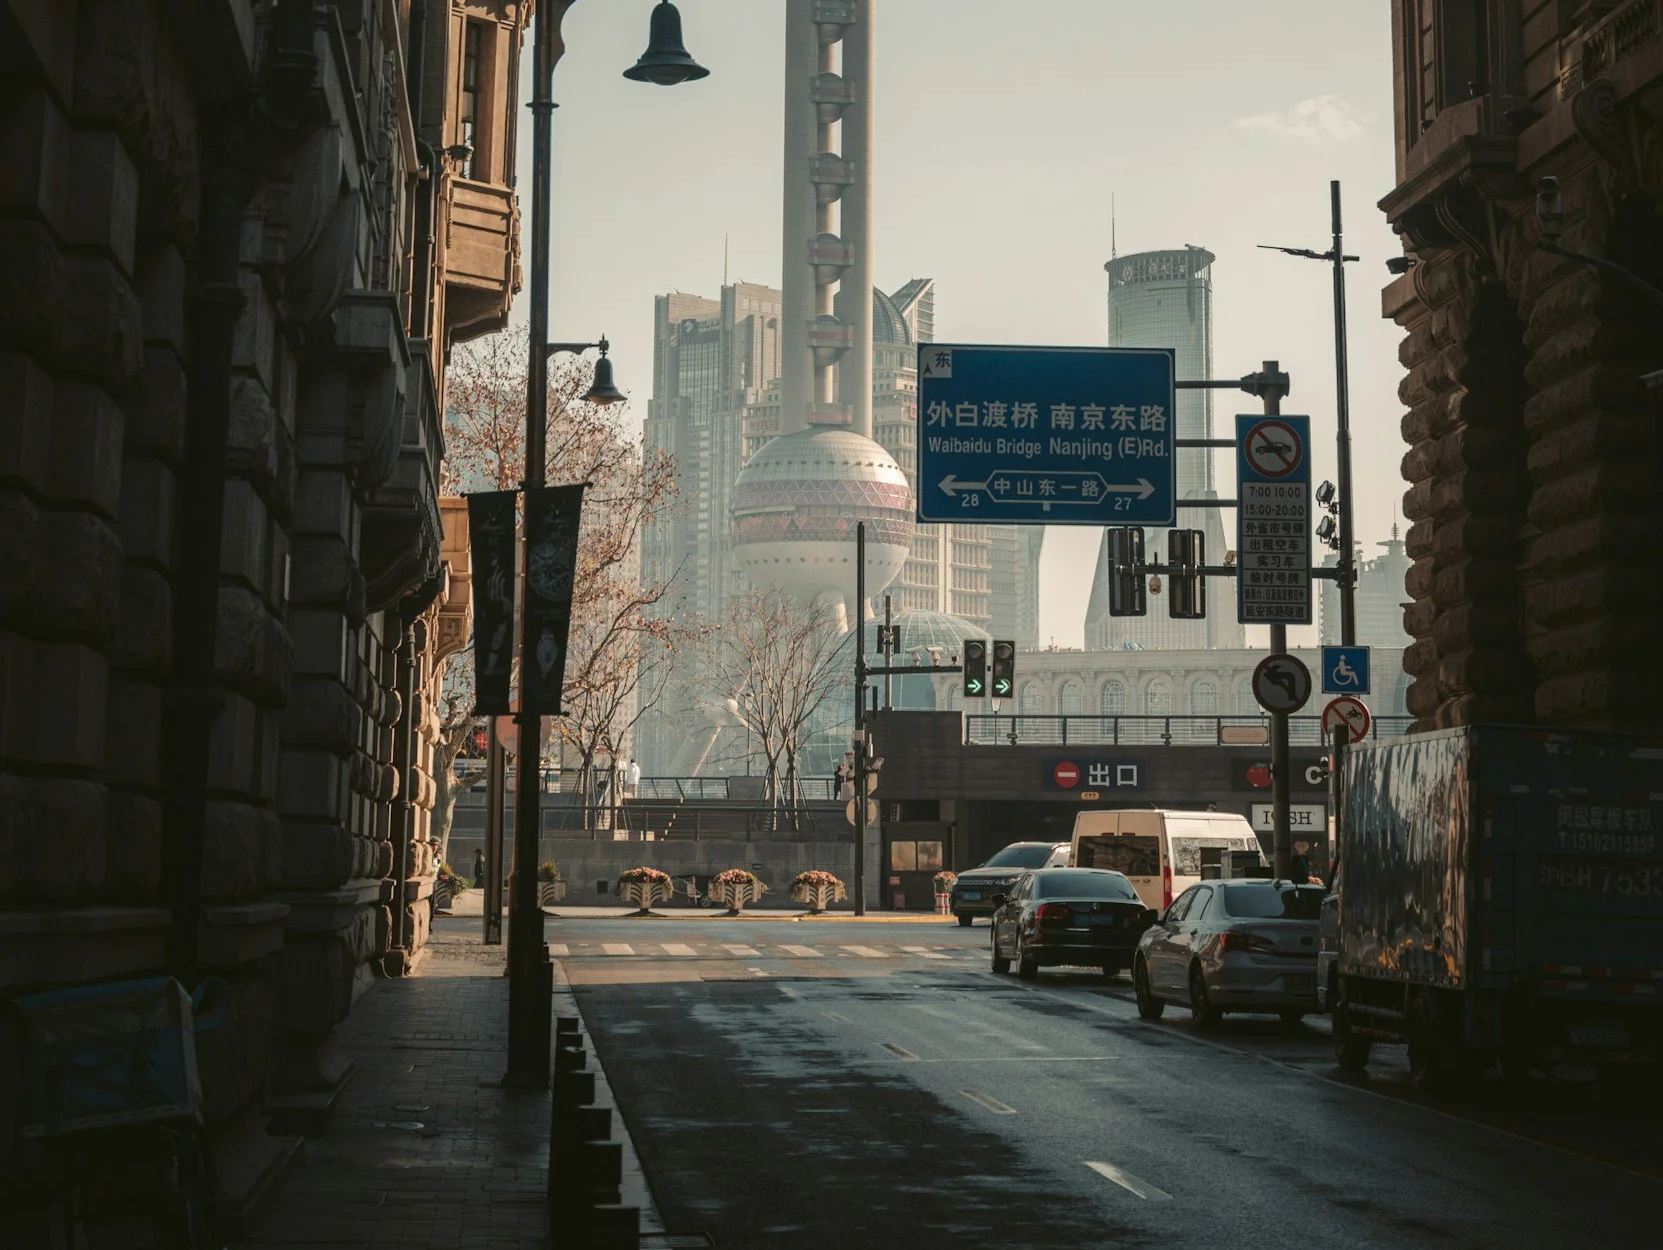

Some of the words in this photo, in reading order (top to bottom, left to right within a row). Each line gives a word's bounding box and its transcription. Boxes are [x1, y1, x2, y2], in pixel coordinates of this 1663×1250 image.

[935, 352, 951, 368] 东
[926, 400, 1038, 429] 外白渡桥
[1049, 402, 1167, 432] 南京东路
[928, 436, 992, 454] Waibaidu
[996, 438, 1042, 459] Bridge
[1049, 437, 1113, 461] Nanjing
[993, 477, 1100, 498] 中山东一路
[1249, 485, 1271, 498] 7:00
[1274, 486, 1301, 499] 10:00
[961, 493, 979, 508] 28
[1114, 497, 1132, 511] 27
[1245, 504, 1304, 517] 15:00-20:00
[1245, 521, 1305, 535] 外省市号牌
[1249, 539, 1300, 551] 出租空车
[1256, 555, 1295, 568] 实习车
[1250, 572, 1300, 584] 临时号牌
[1088, 762, 1139, 788] 出口
